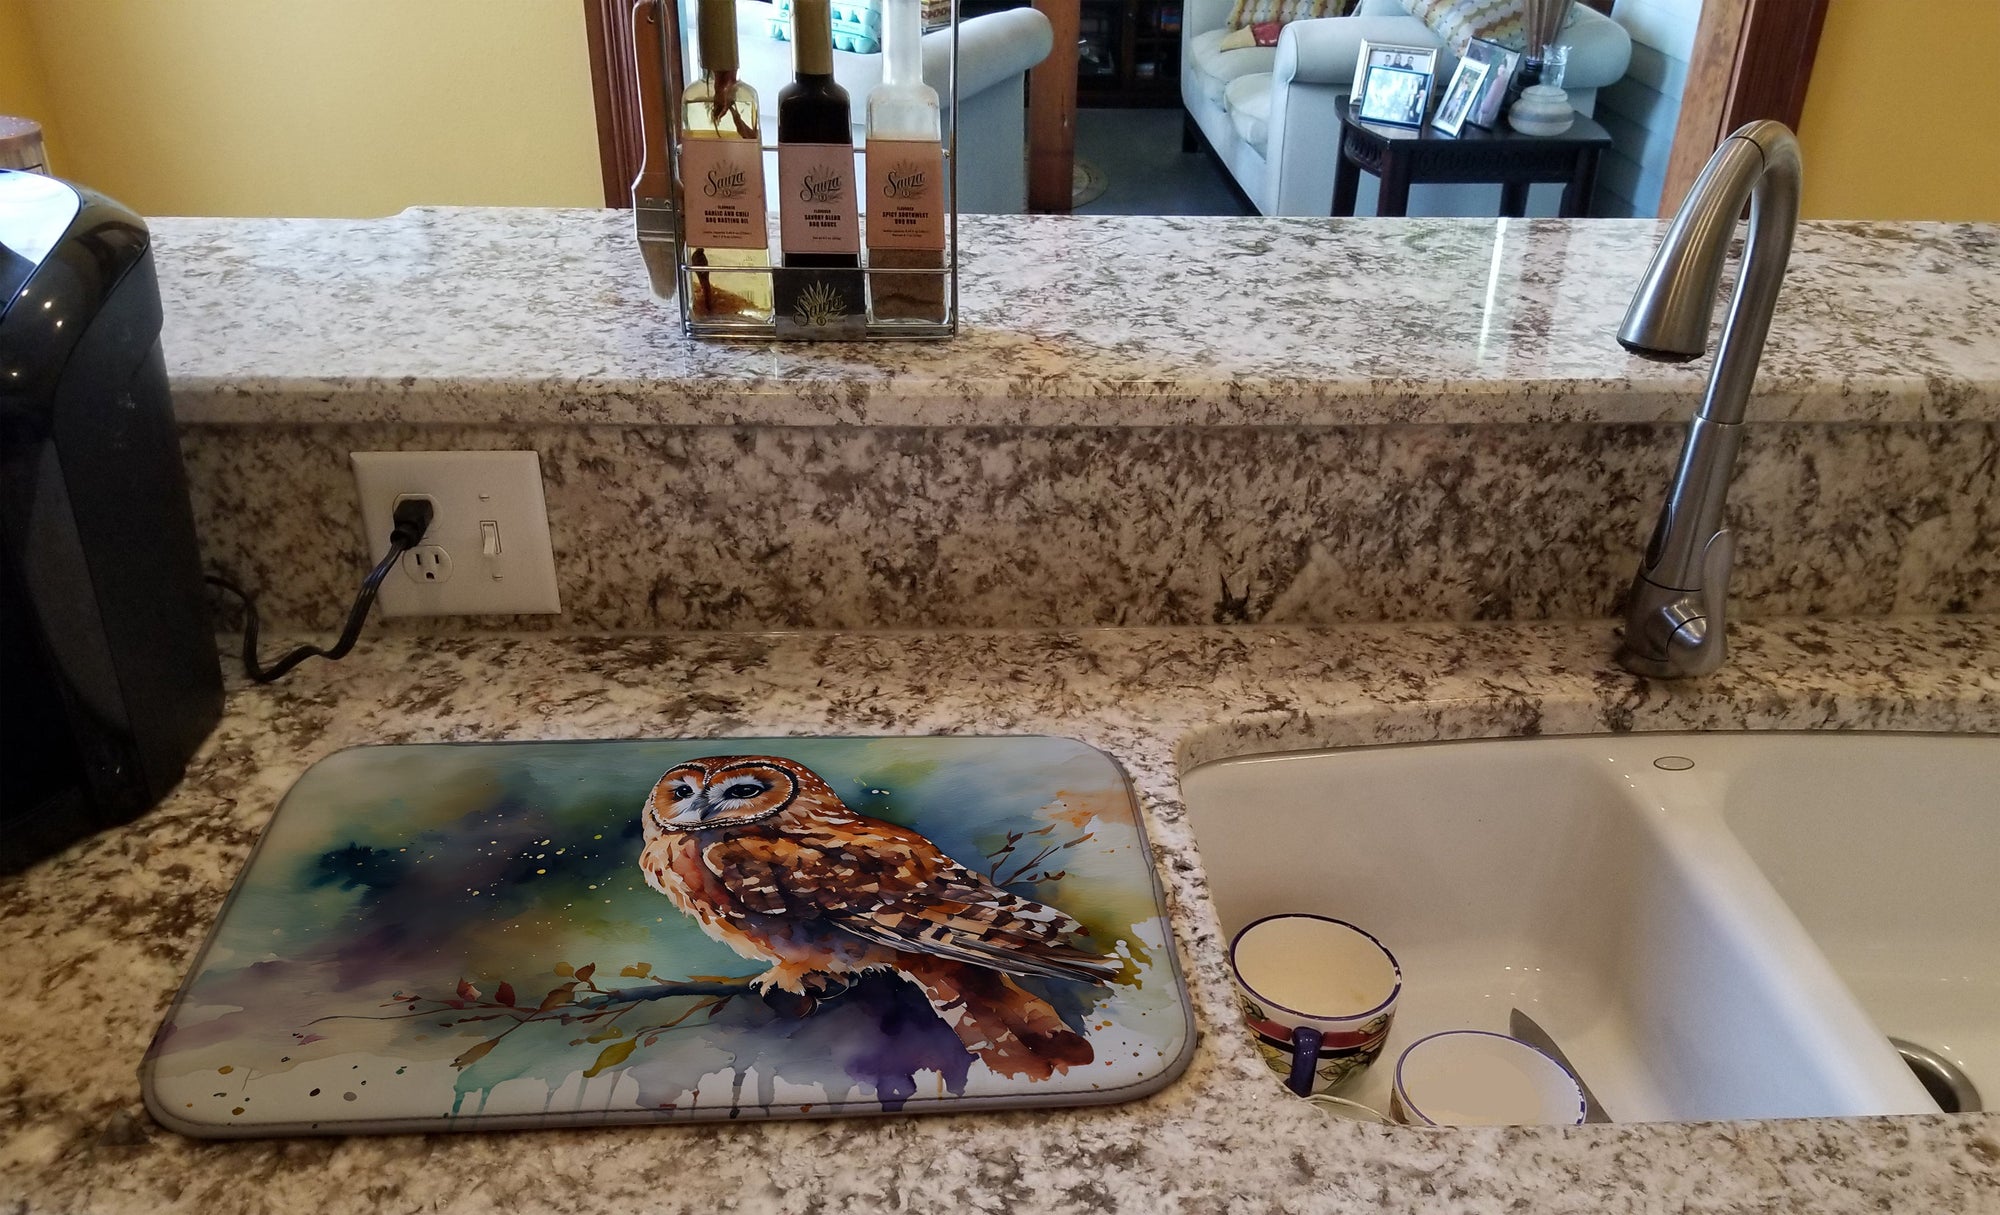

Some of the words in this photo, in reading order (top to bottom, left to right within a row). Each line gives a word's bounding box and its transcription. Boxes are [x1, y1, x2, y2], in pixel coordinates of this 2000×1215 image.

[703, 170, 745, 197] Sauza
[800, 175, 841, 202] Sauza
[883, 171, 924, 198] Sauza
